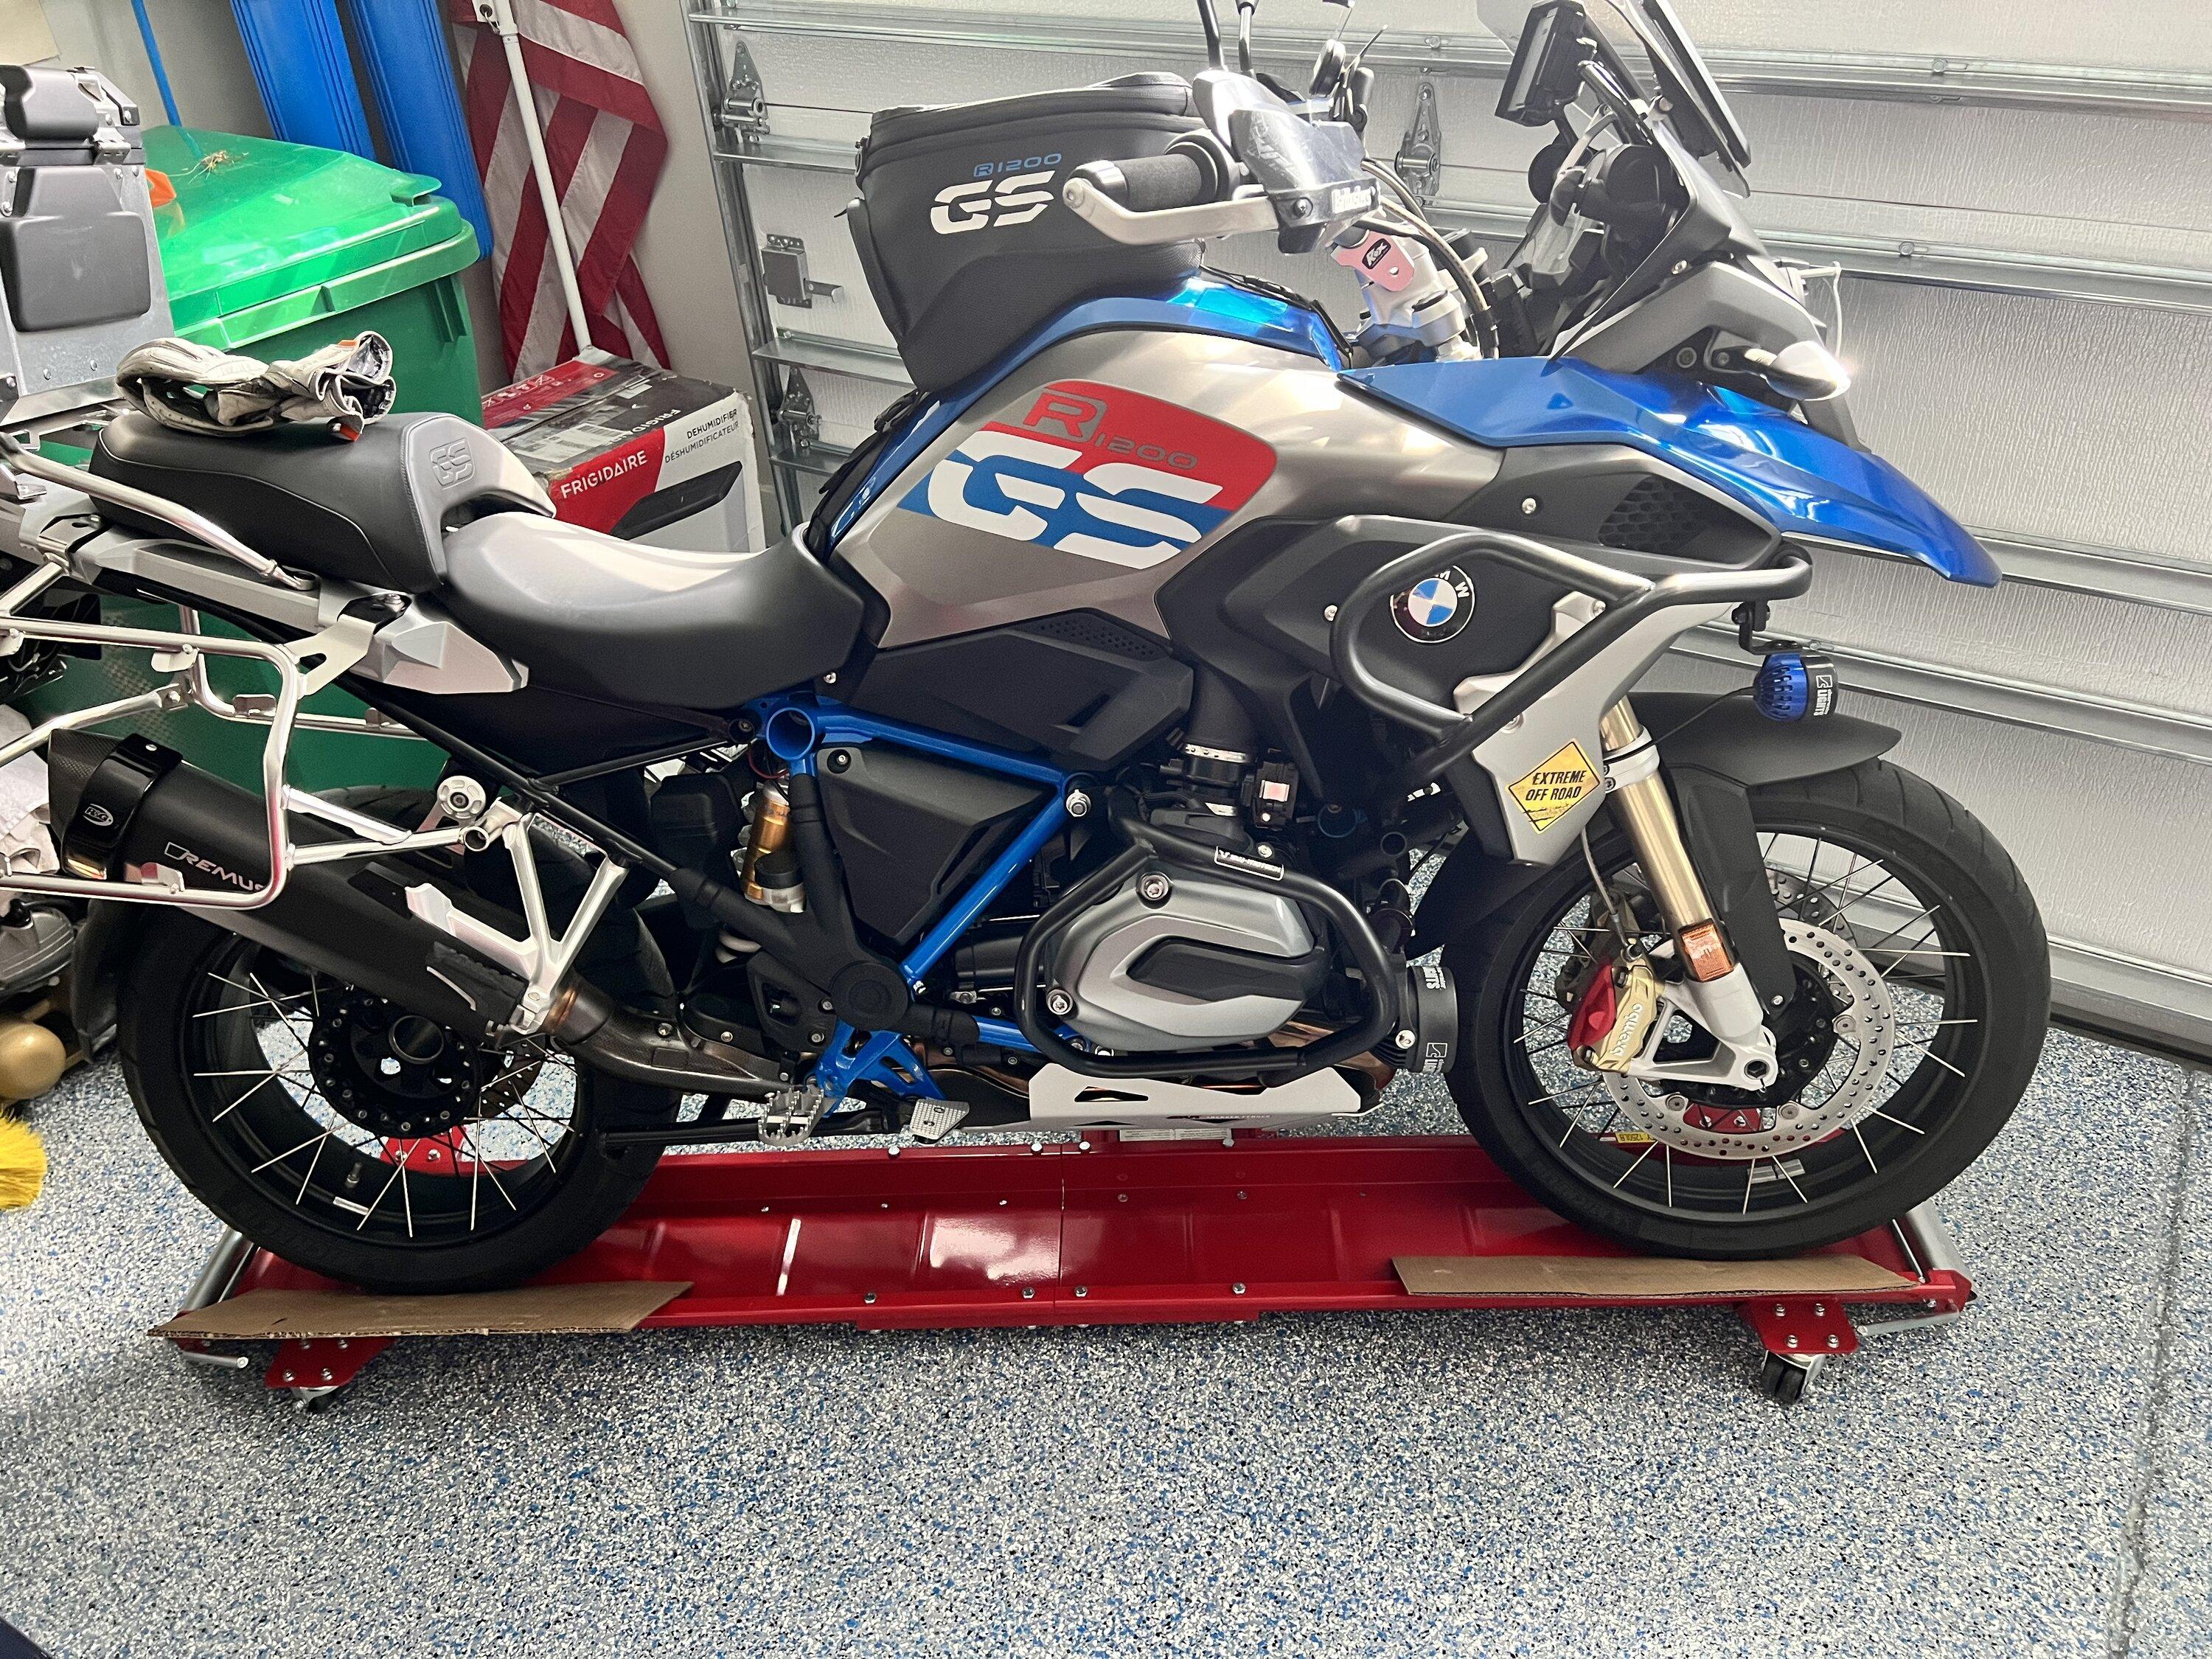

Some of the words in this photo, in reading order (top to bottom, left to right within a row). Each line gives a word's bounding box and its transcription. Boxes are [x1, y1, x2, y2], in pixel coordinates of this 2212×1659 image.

[931, 170, 1056, 234] GS
[664, 421, 740, 463] DÉSHUMIDIFICATEUR
[686, 408, 737, 439] DEHUMIDIFIER
[560, 450, 648, 499] FRIGIDAIRE
[928, 431, 1223, 569] GS
[1525, 788, 1548, 801] OFF
[1550, 785, 1582, 801] ROAD
[1531, 770, 1587, 785] EXTREME
[1608, 1003, 1644, 1057] brembo
